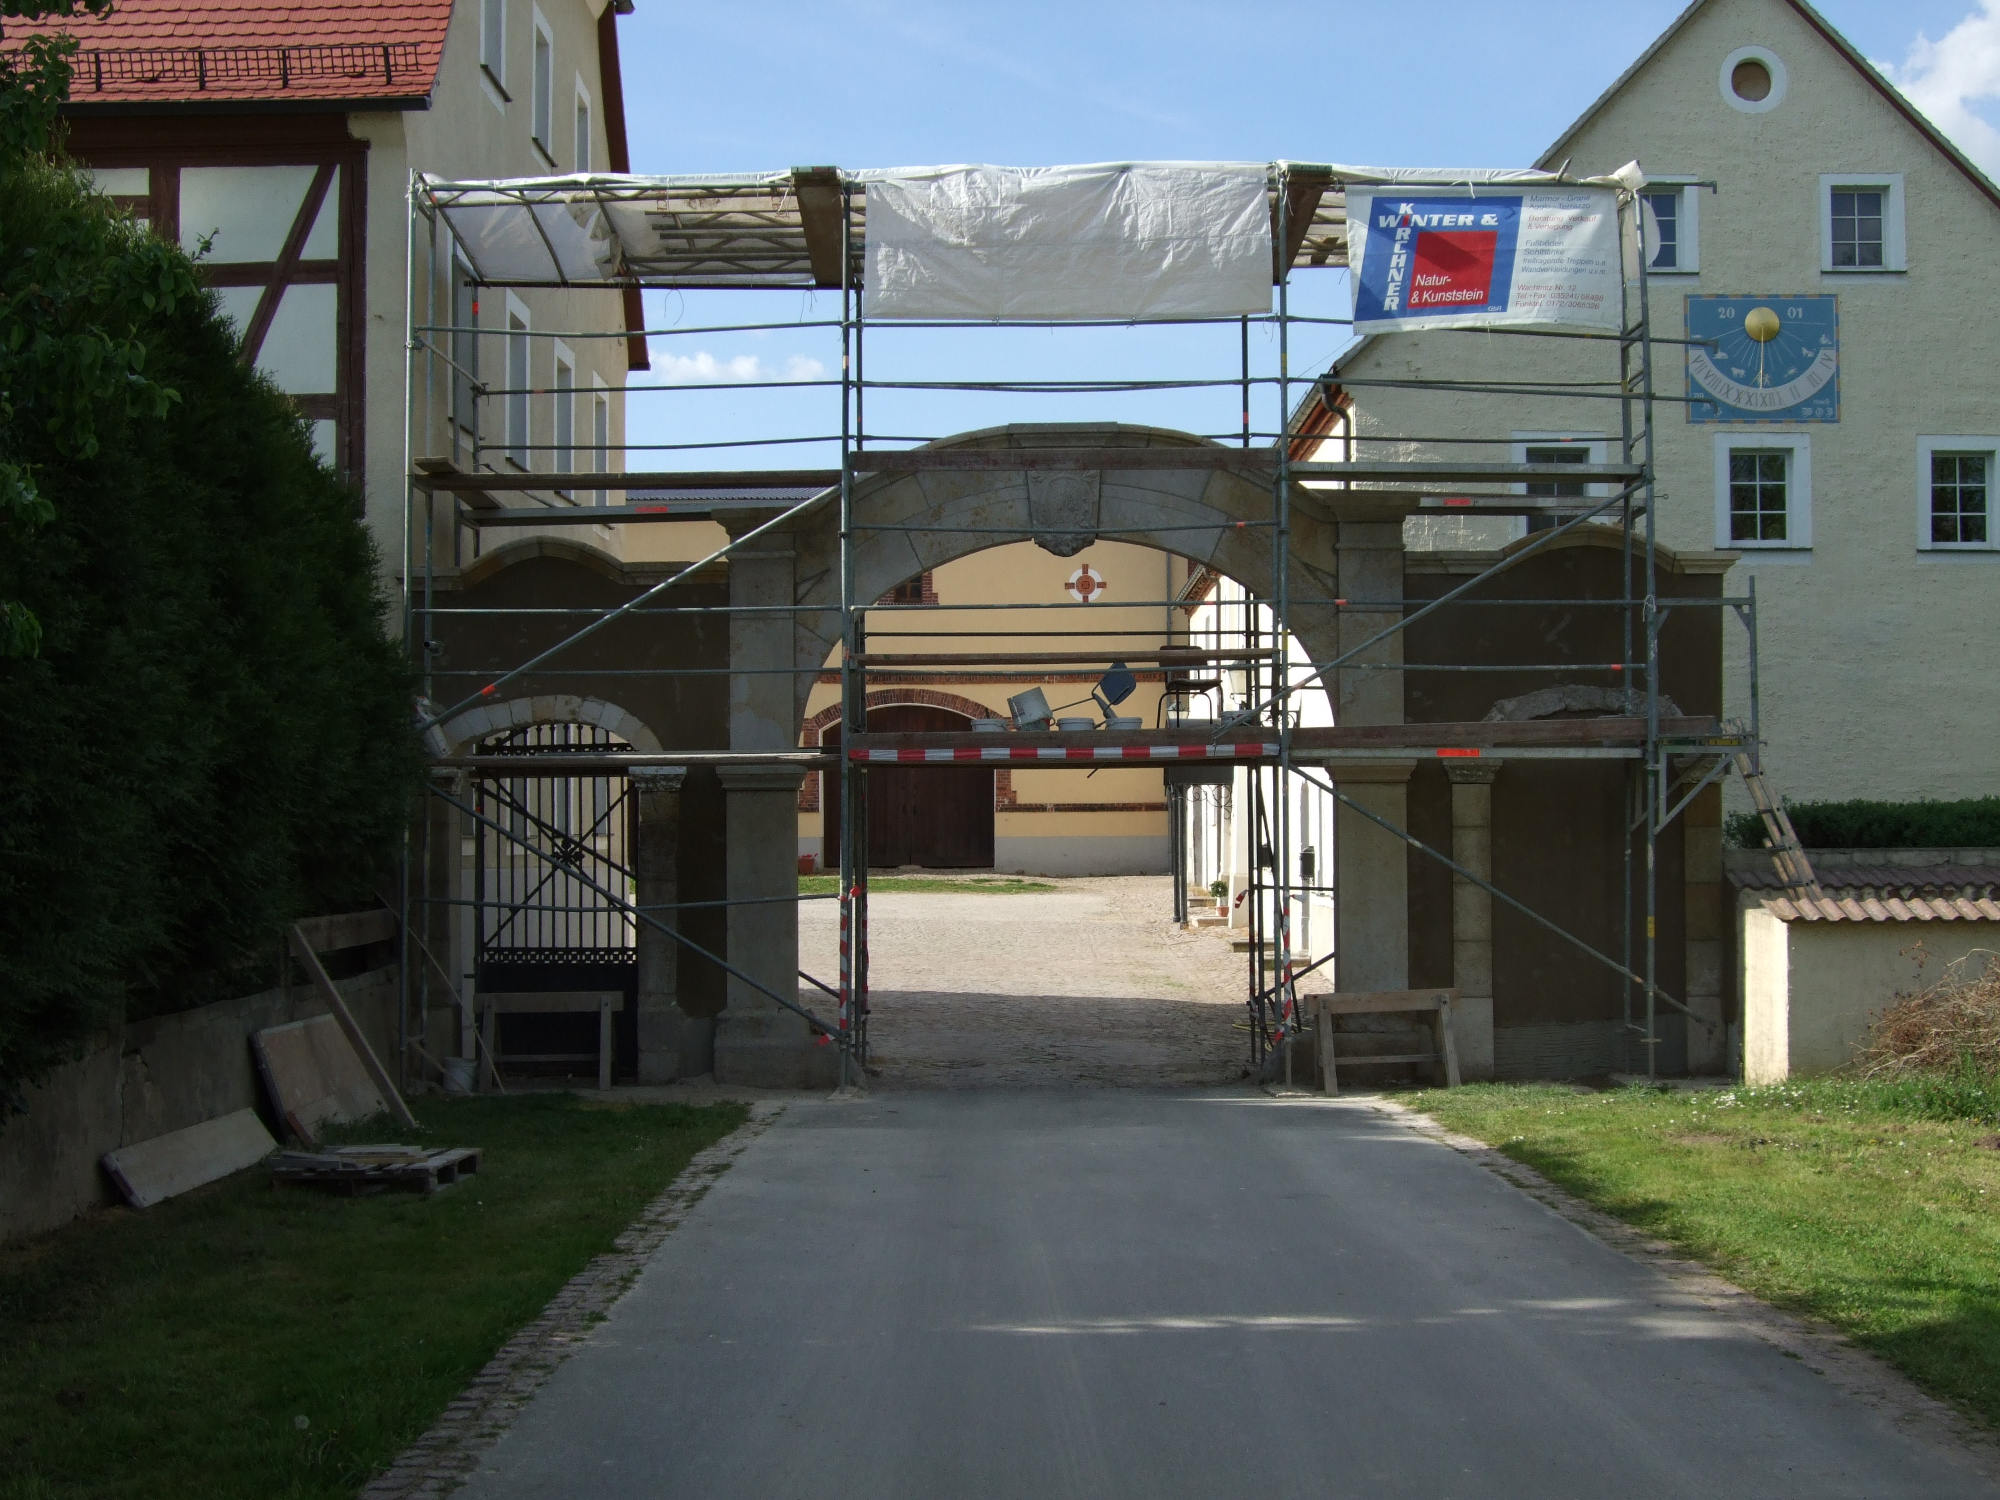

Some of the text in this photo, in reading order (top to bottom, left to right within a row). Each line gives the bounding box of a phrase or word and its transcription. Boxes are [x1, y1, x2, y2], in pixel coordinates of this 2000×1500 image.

[1379, 213, 1499, 228] WINTER &
[1383, 203, 1415, 311] KIRCHNER
[1415, 274, 1452, 286] Natur-
[1411, 288, 1484, 304] & Kunststein
[1718, 306, 1803, 319] 20 01
